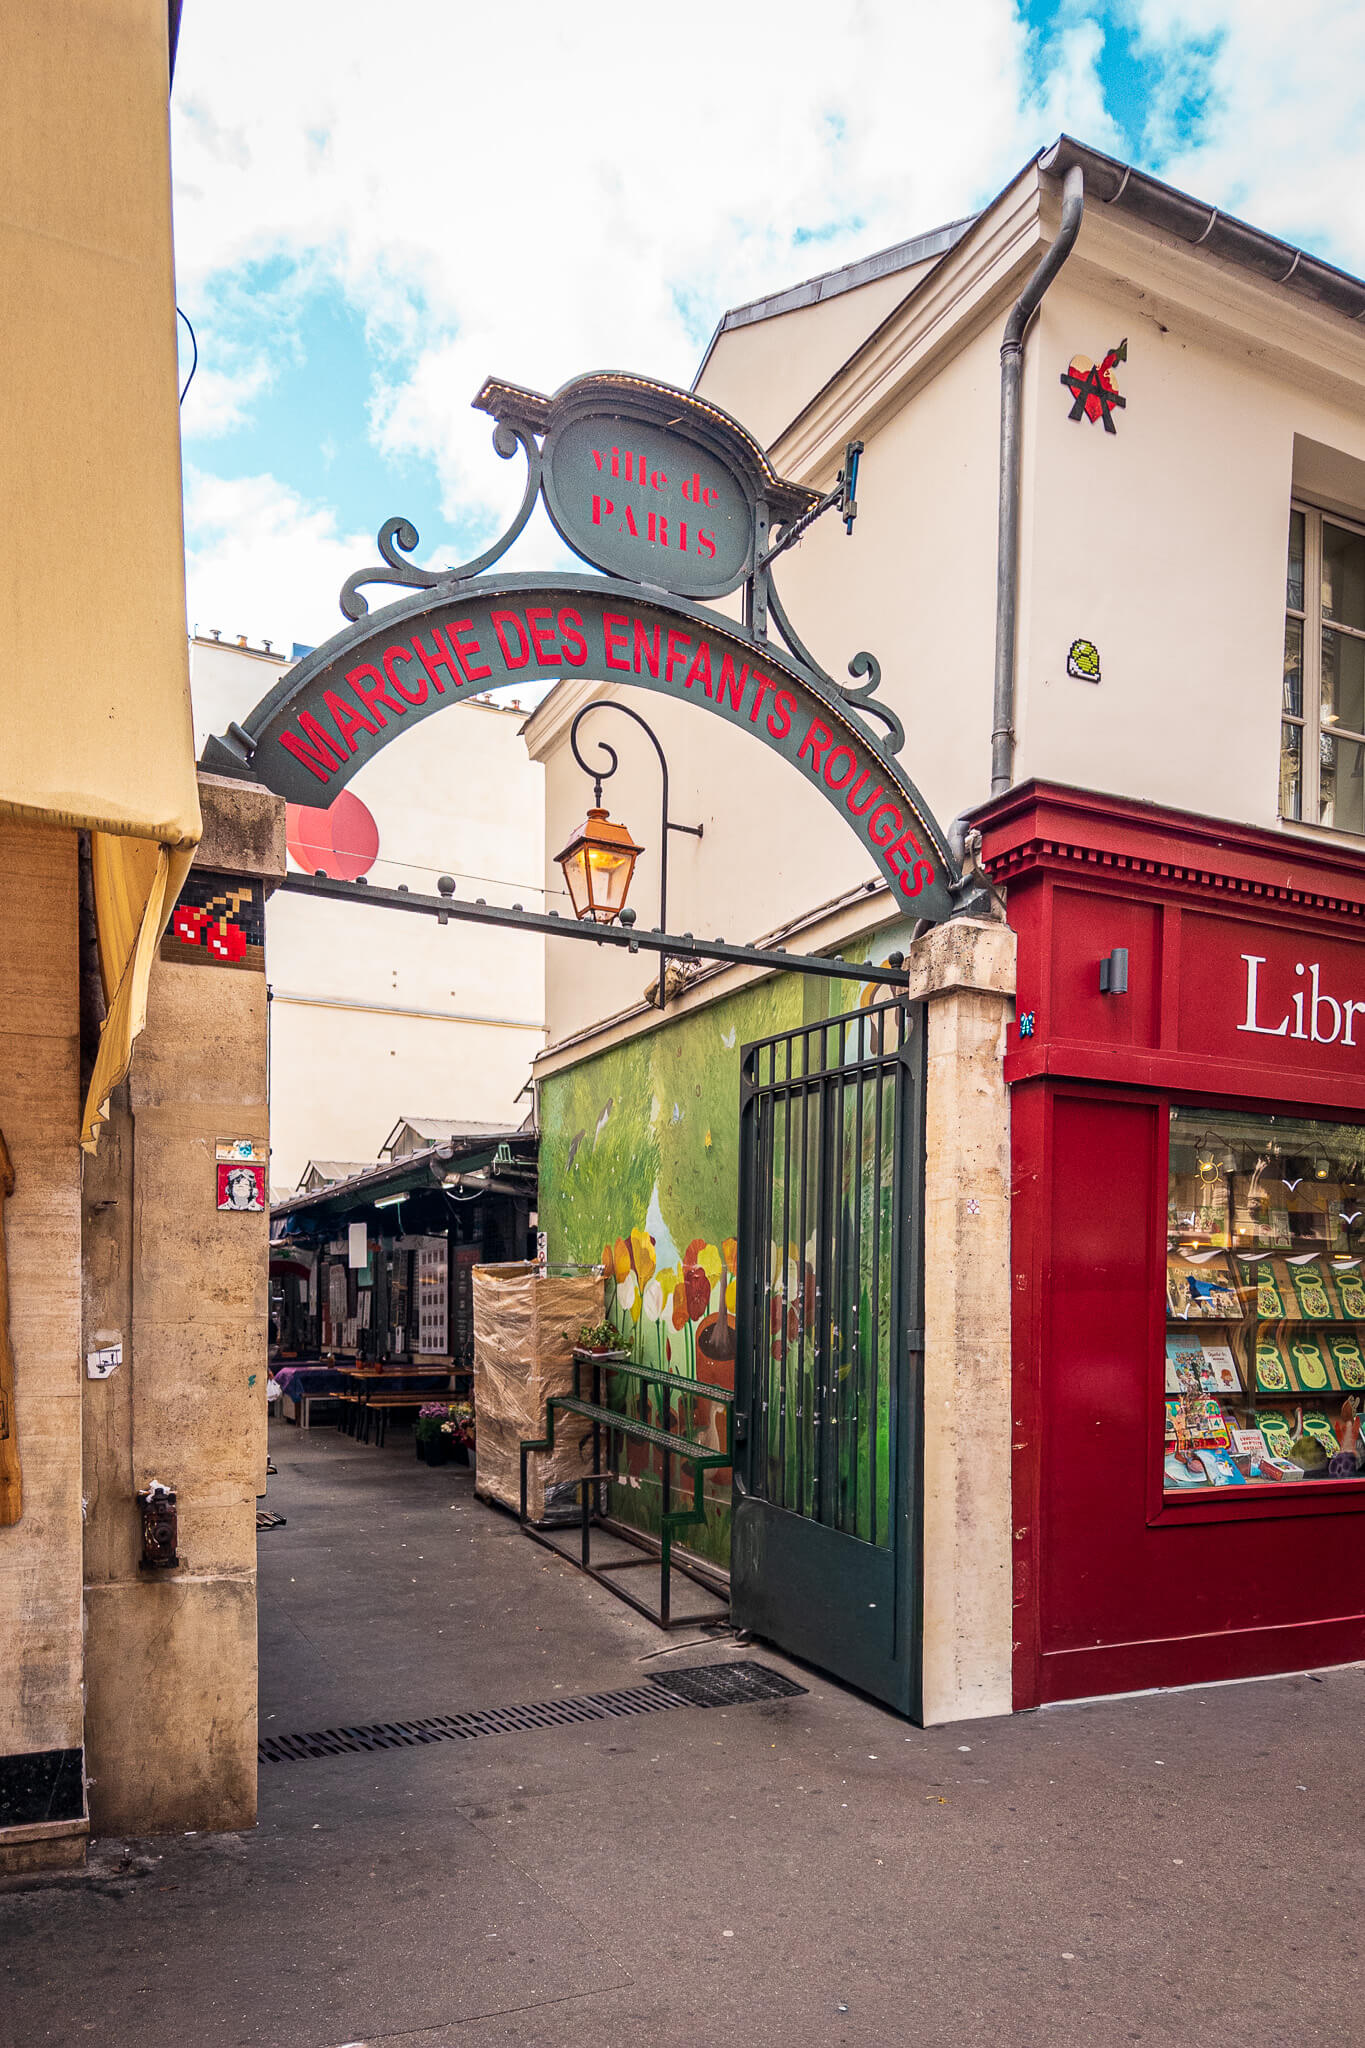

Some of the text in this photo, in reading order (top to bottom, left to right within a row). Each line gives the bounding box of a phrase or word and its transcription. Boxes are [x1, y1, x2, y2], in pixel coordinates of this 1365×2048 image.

[591, 446, 719, 508] ville de
[591, 495, 717, 559] PARIS
[278, 607, 938, 899] MARCHE DES ENFANTS ROUGES
[1236, 953, 1365, 1047] Libr
